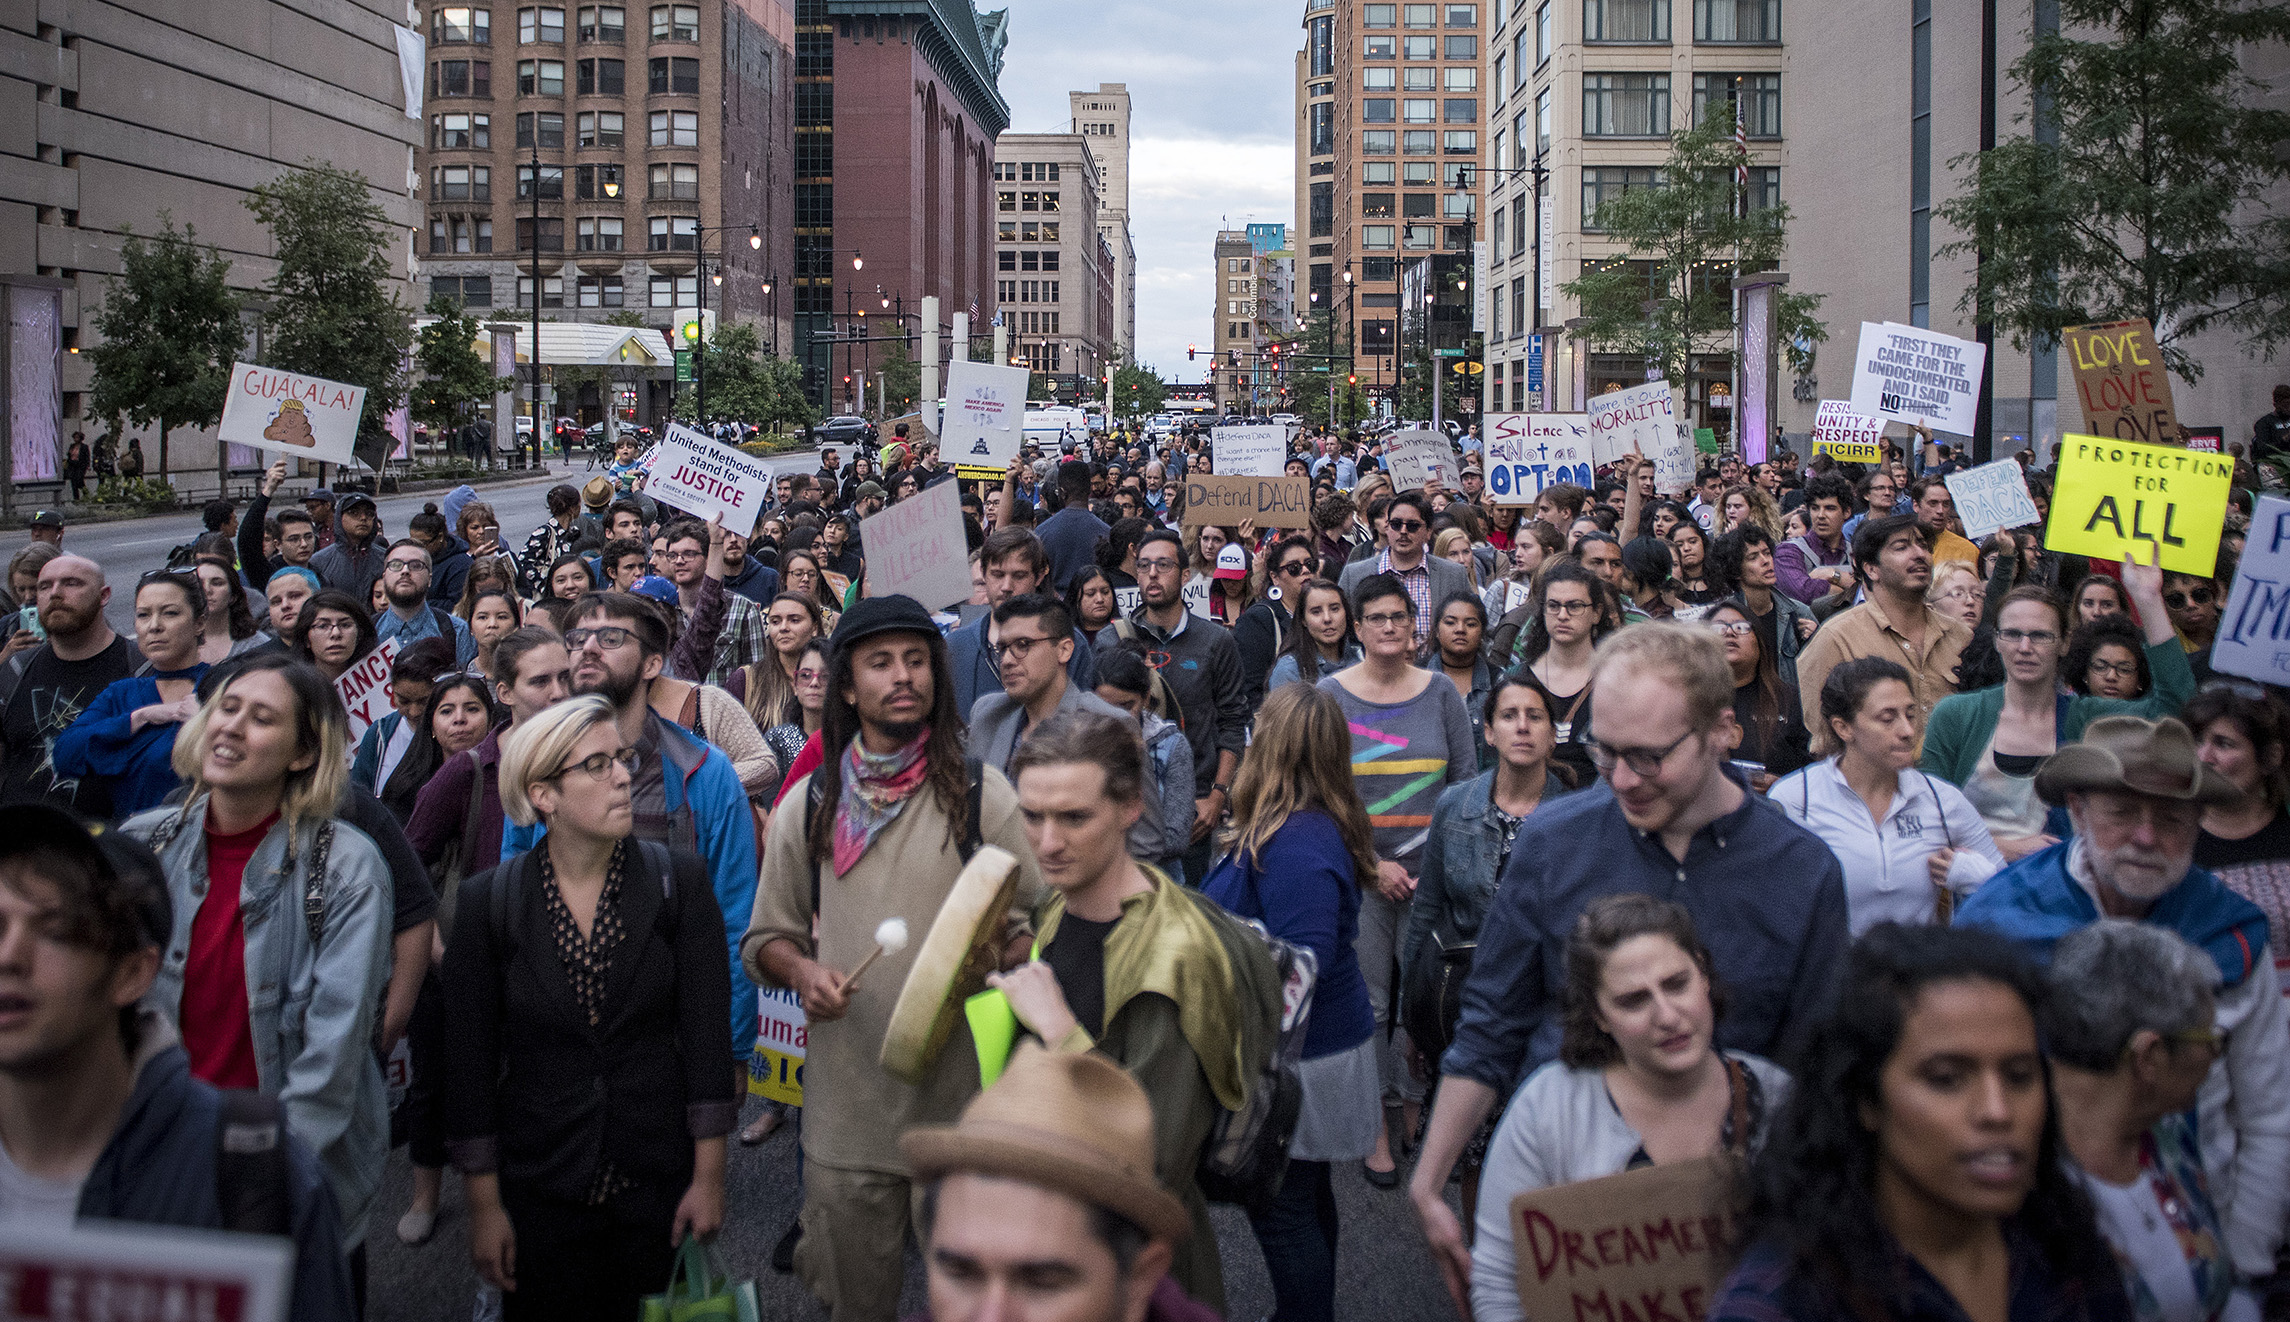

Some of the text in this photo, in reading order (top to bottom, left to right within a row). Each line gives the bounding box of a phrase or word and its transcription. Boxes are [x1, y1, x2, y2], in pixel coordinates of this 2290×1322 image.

[1248, 274, 1258, 319] Columbia
[1877, 347, 1966, 378] CAME FOR THE
[1930, 341, 1962, 361] THEY
[2072, 331, 2150, 370] LOVE
[1868, 360, 1972, 396] UNDOCUMENTED,
[1882, 378, 1950, 406] AND I SAID
[2081, 371, 2162, 412] LOVE
[1624, 395, 1634, 406] is
[1495, 415, 1563, 440] Silence
[1591, 397, 1672, 436] MORALITY?
[1818, 414, 1876, 429] UNITY &
[2092, 410, 2174, 442] LOVE
[1506, 439, 1549, 462] Not
[1554, 446, 1577, 460] an
[1816, 428, 1879, 444] RESPECT
[1830, 444, 1875, 456] ICIRR
[670, 430, 768, 483] United Methodists
[1216, 446, 1224, 456] I
[1392, 454, 1420, 473] pay
[2078, 444, 2233, 480] PROTECTION
[688, 456, 740, 484] stand for
[1396, 474, 1427, 488] than
[1951, 463, 2020, 494] DEFEND
[662, 483, 682, 494] CHURCH
[686, 492, 706, 504] SOCIETY
[670, 465, 745, 508] JUSTICE
[1188, 482, 1306, 513] Defend DACA
[2135, 476, 2169, 494] FOR
[1961, 486, 2034, 528] DACA
[2084, 495, 2186, 547] ALL
[884, 532, 953, 588] ILLEGAL
[1220, 556, 1240, 564] SOX
[1183, 584, 1208, 600] NAL
[335, 644, 396, 706] ANCE
